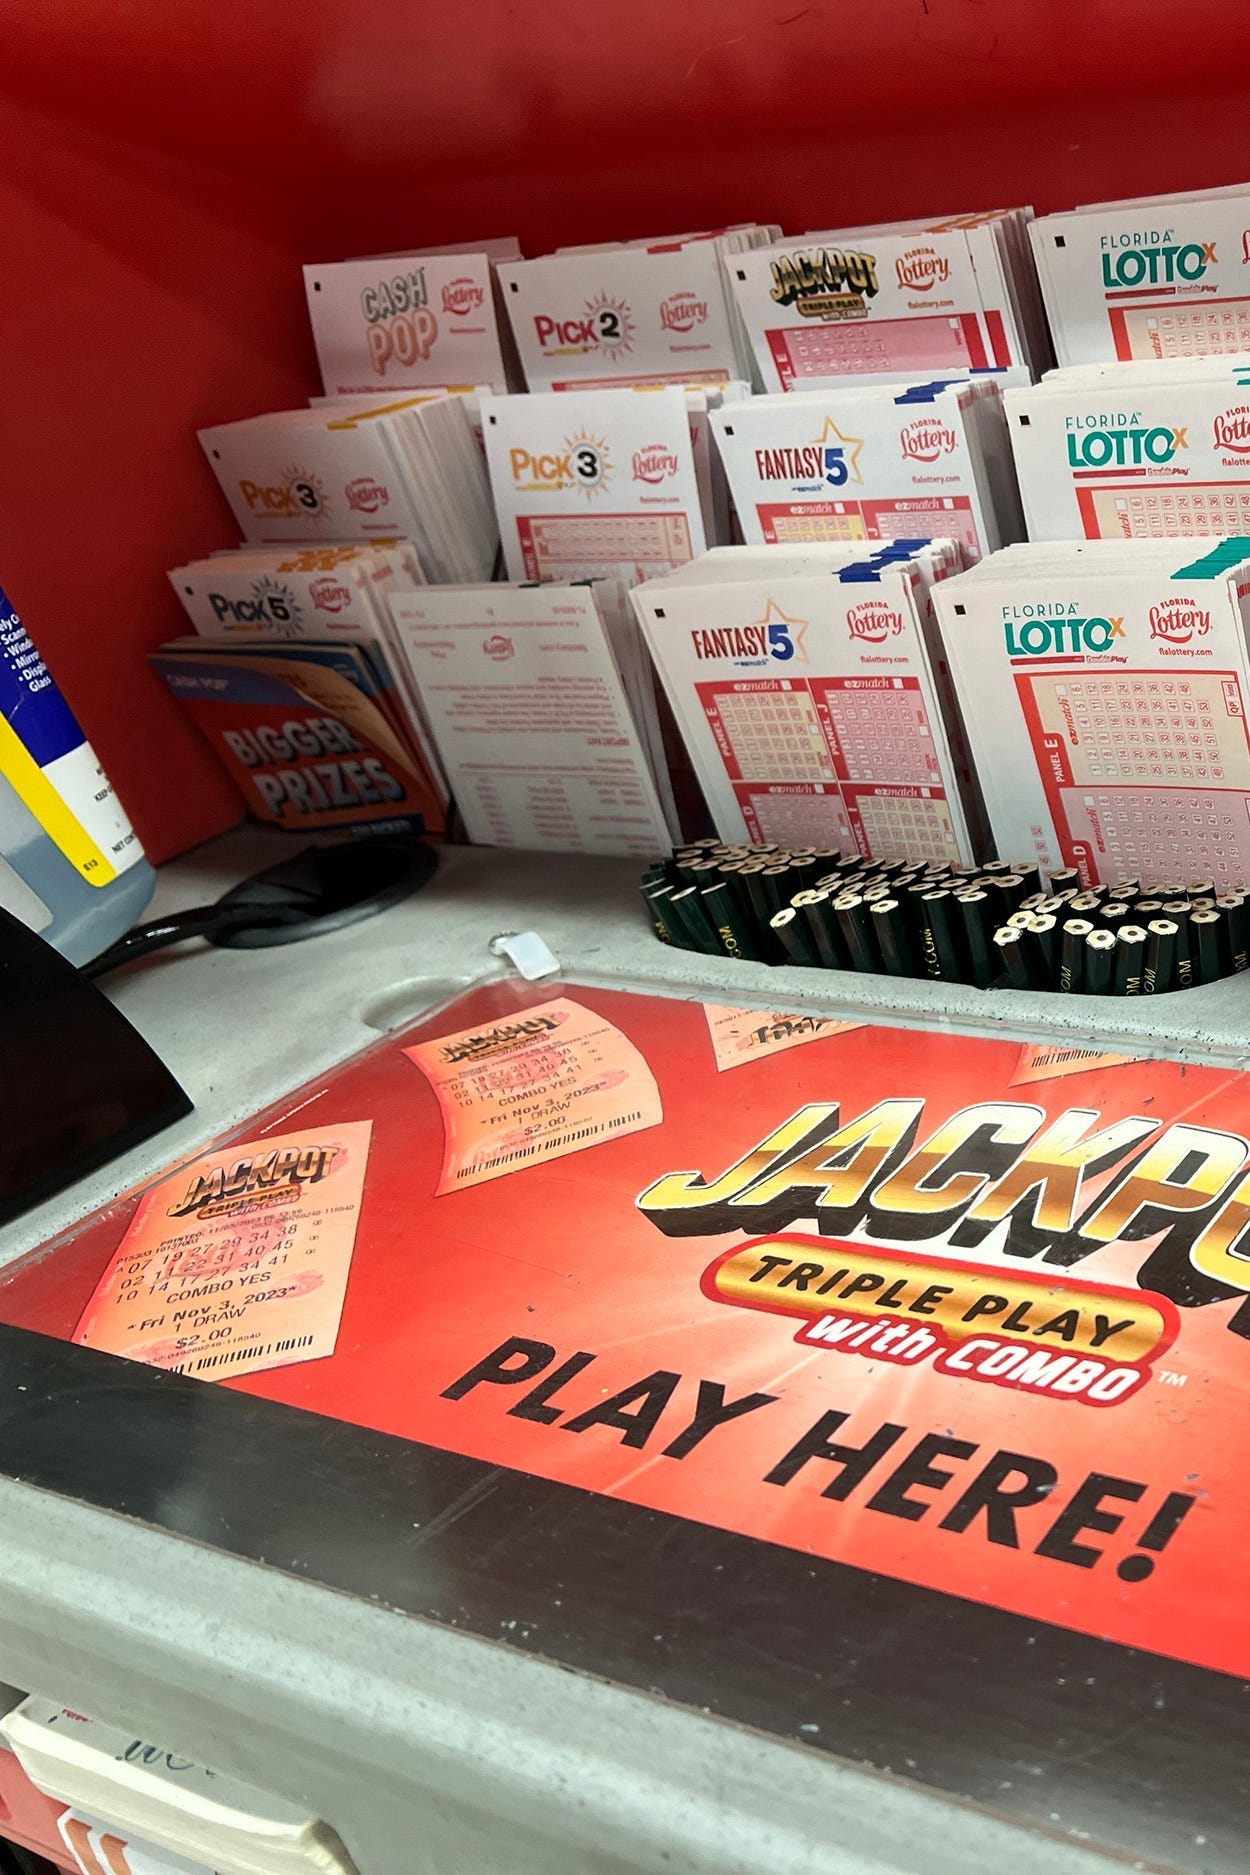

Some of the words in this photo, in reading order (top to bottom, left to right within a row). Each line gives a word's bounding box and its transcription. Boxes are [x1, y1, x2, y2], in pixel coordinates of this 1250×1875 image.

[1101, 230, 1172, 249] FLORIDA
[904, 248, 935, 259] FLORIDA
[769, 247, 879, 305] JACKPOT
[895, 256, 951, 292] Lottery
[361, 266, 428, 323] CASH
[441, 283, 484, 316] Lottery
[600, 312, 620, 338] 2
[660, 298, 709, 333] Lottery
[367, 307, 437, 375] POP
[910, 419, 942, 430] FLORIDA
[1066, 413, 1139, 429] FLORIDA
[900, 428, 957, 462] Lottery
[577, 451, 598, 477] 3
[632, 452, 679, 485] Lottery
[856, 601, 888, 612] FLORIDA
[1002, 603, 1077, 618] FLORIDA
[1160, 598, 1195, 609] FLORIDA
[847, 609, 904, 643] Lottery
[1149, 607, 1213, 643] Lottery
[861, 656, 909, 664] flalottery.com
[1159, 647, 1213, 657] flalottery.com
[29, 676, 51, 692] Glass
[734, 680, 778, 691] ezmatch
[844, 678, 889, 689] ezmatch
[222, 718, 366, 768] BIGGER
[1055, 754, 1065, 782] PANEL
[254, 758, 406, 818] PRIZES
[498, 1087, 547, 1107] COMBO
[551, 1077, 577, 1090] YES
[512, 1104, 539, 1117] Nov
[531, 1102, 571, 1120] DRAW
[167, 1146, 340, 1217] JACKPOT
[167, 1280, 232, 1304] COMBO
[240, 1272, 272, 1287] YES
[746, 1254, 970, 1315] TRIPLE
[971, 1293, 1141, 1349] PLAY
[173, 1306, 212, 1322] Nov
[193, 1308, 247, 1326] DRAW
[175, 1327, 233, 1349] $2.00
[802, 1310, 933, 1361] with
[943, 1332, 1145, 1402] COMBO
[439, 1336, 781, 1461] PLAY
[763, 1409, 1197, 1584] HERE!
